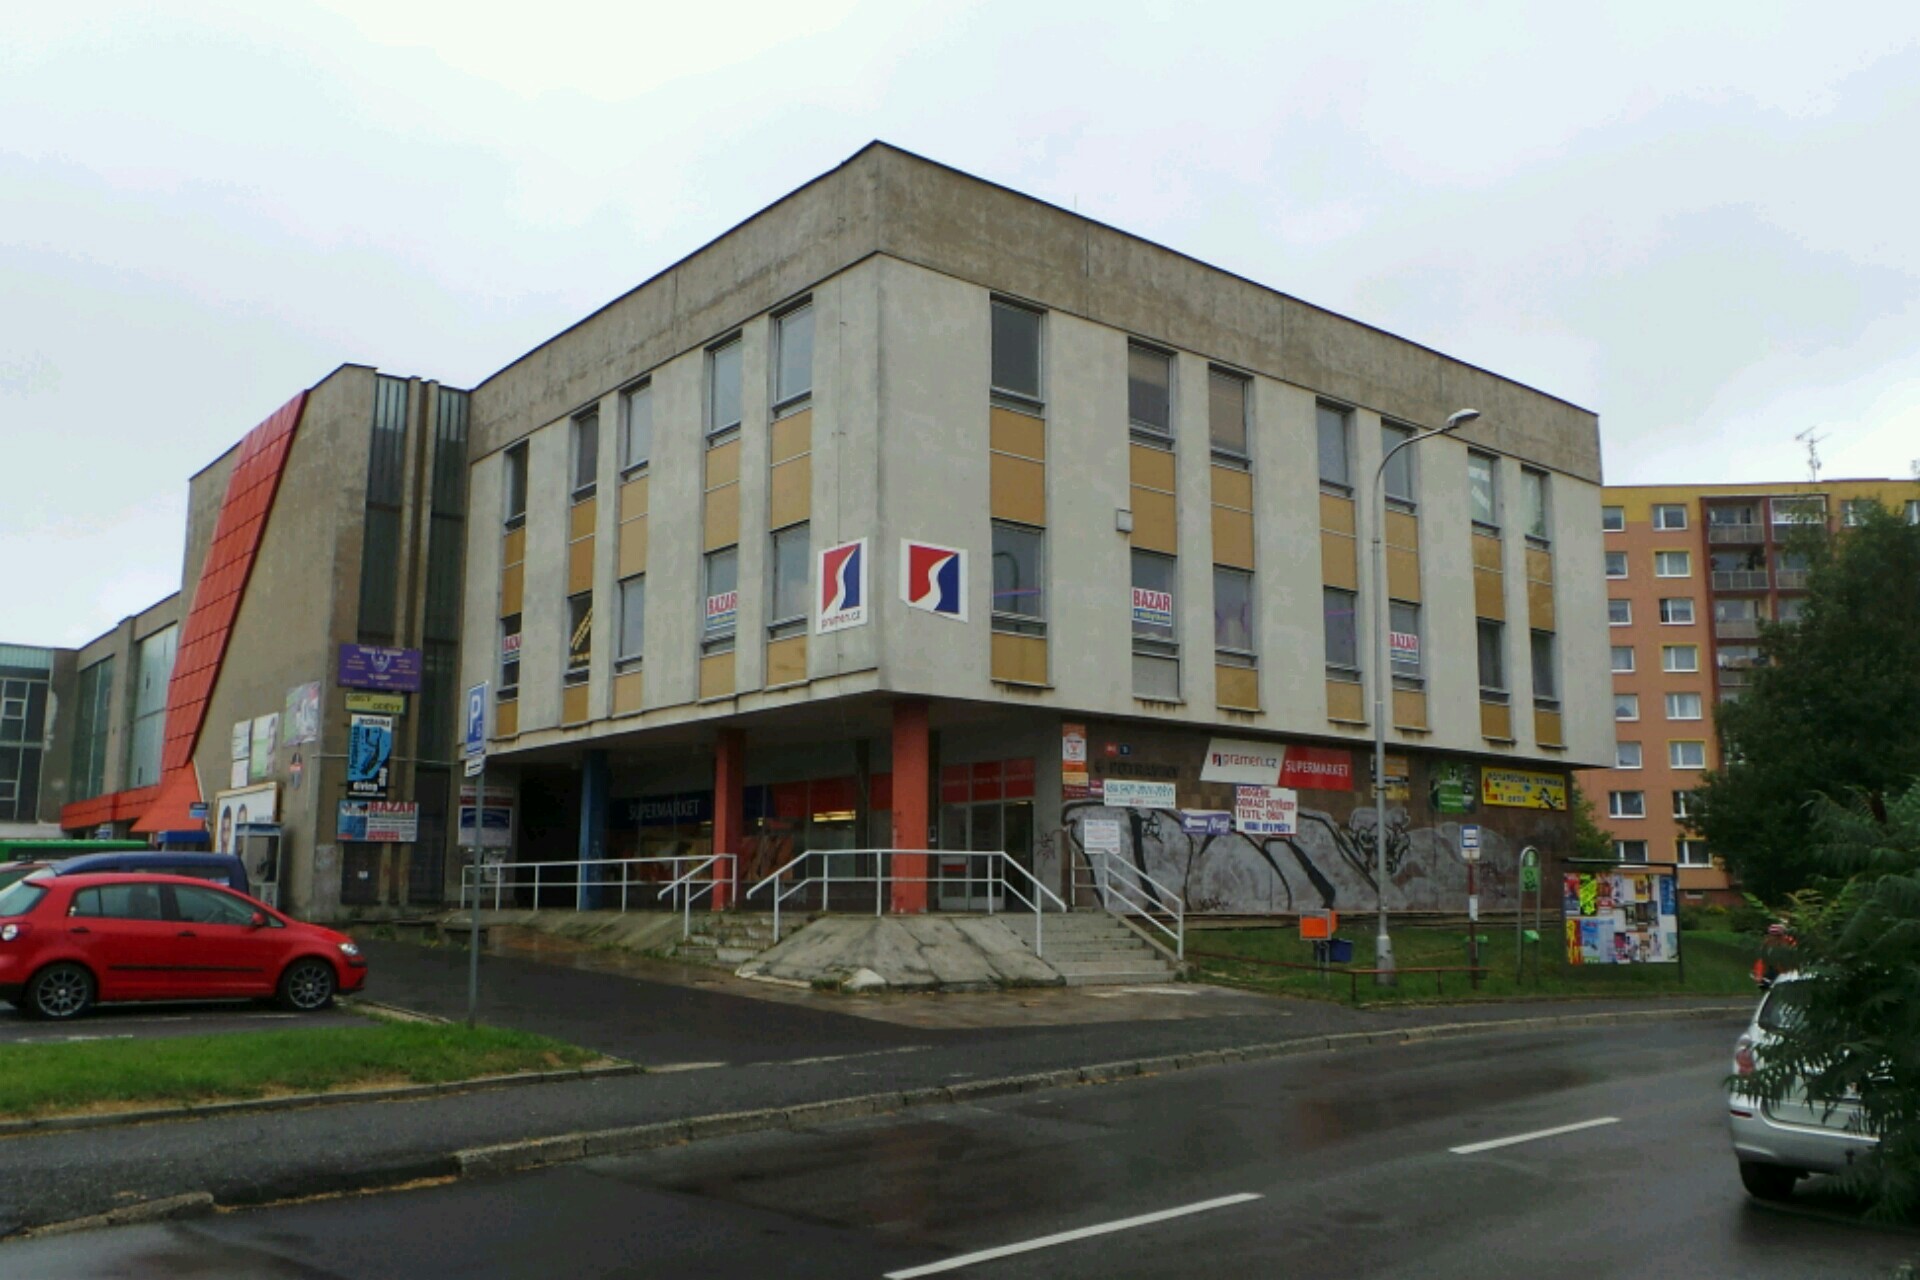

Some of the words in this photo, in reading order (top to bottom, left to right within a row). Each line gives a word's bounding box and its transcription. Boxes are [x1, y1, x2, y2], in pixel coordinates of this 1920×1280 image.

[1133, 590, 1170, 611] BAZAR
[821, 609, 860, 630] pramen.cz
[469, 695, 480, 735] P
[1221, 753, 1277, 769] pramen.cz
[1285, 760, 1349, 777] SUPERMARKET
[369, 801, 416, 814] BAZAR
[629, 800, 700, 821] SUPERMARKET
